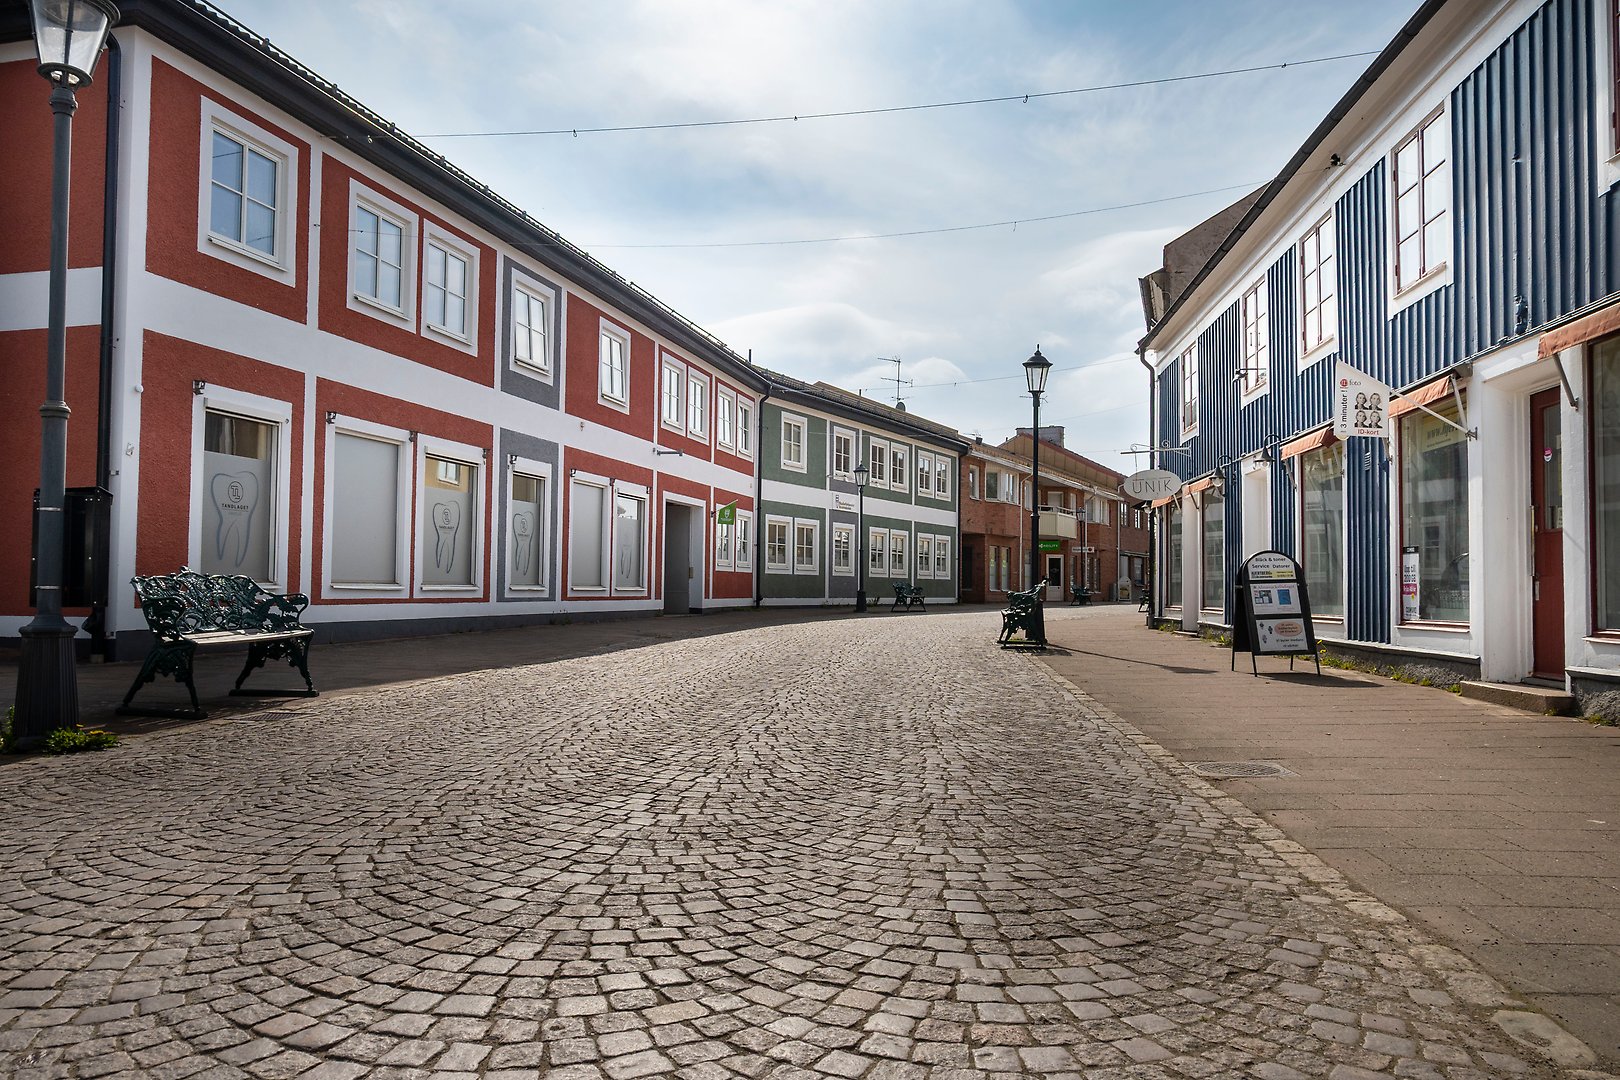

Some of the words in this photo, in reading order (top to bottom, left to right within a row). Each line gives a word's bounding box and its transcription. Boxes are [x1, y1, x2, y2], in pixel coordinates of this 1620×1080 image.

[1340, 394, 1348, 422] minuter
[1357, 428, 1380, 436] ID-kort
[1132, 479, 1173, 494] UNIK
[221, 503, 249, 511] TANDLAGET
